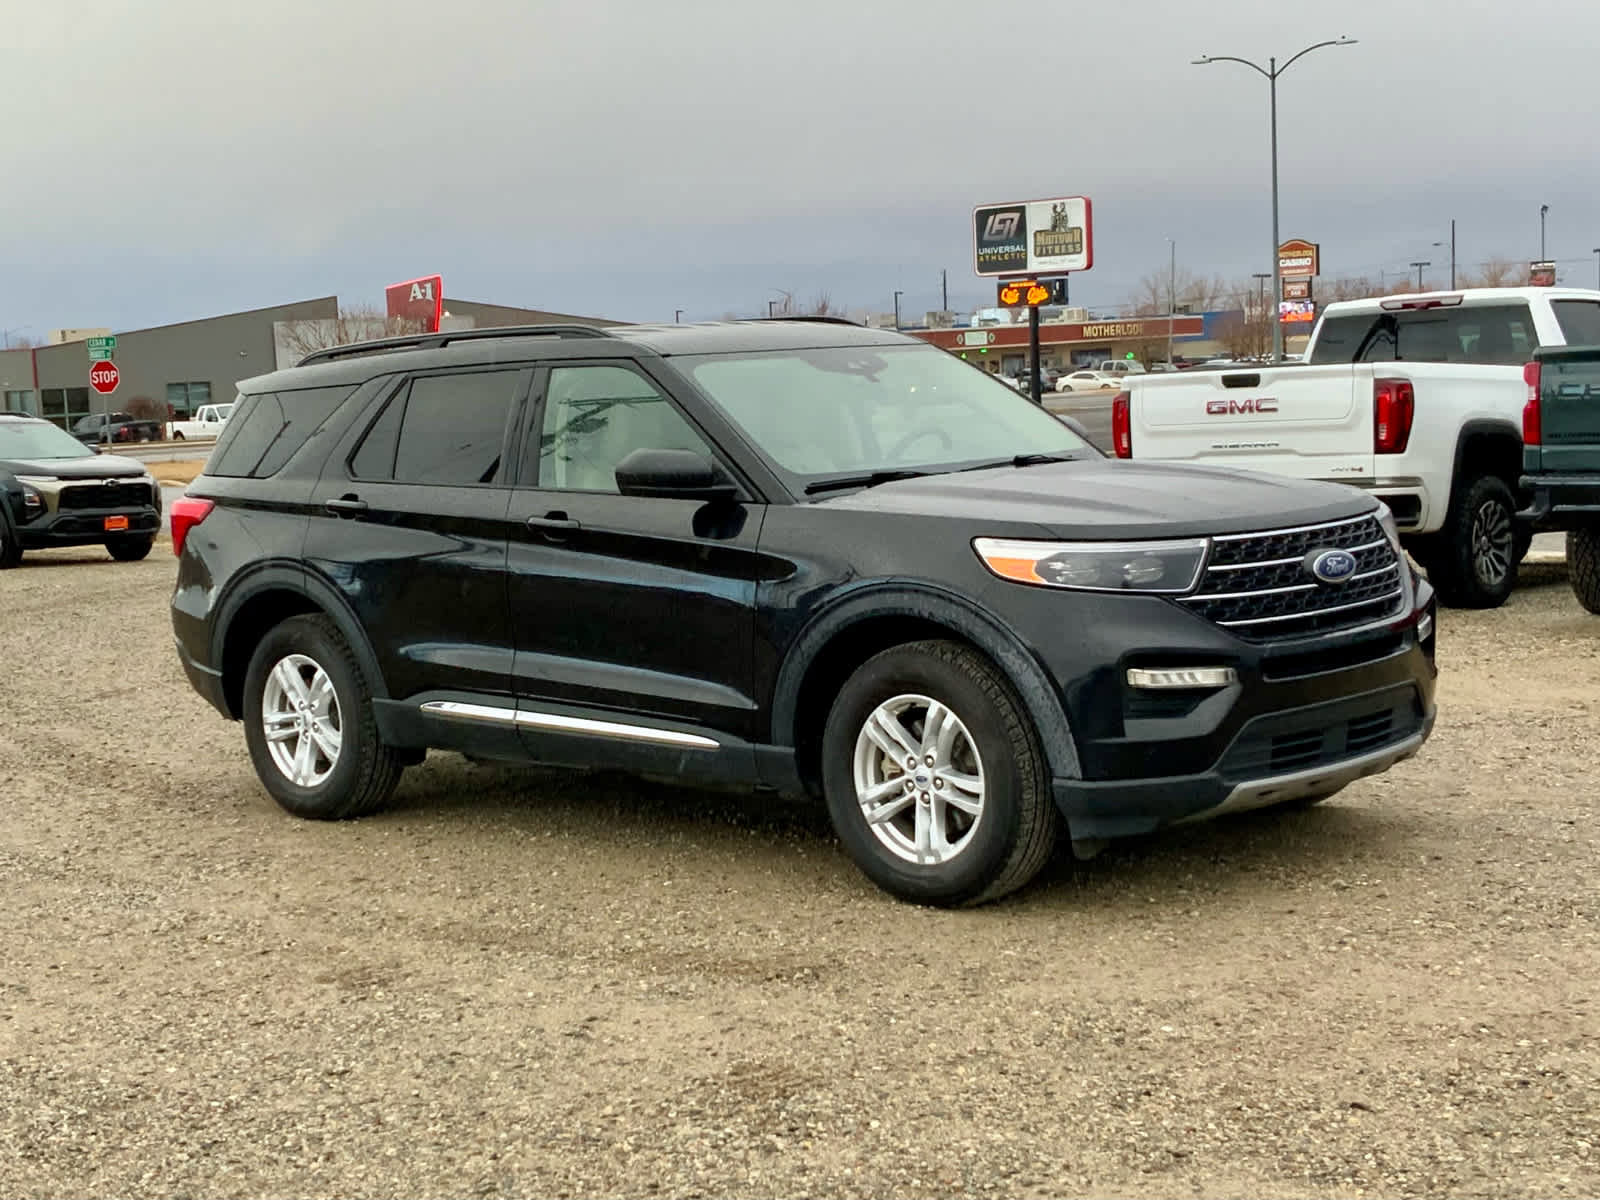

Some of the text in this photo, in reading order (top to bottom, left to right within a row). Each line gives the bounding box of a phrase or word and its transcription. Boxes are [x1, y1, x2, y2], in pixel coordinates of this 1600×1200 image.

[978, 245, 1026, 255] UNIVERSAL
[1035, 244, 1081, 256] FITNESS
[978, 252, 1027, 262] ATHLETIC
[92, 370, 117, 384] STOP
[1206, 398, 1279, 415] GMC
[1326, 556, 1350, 575] Ford
